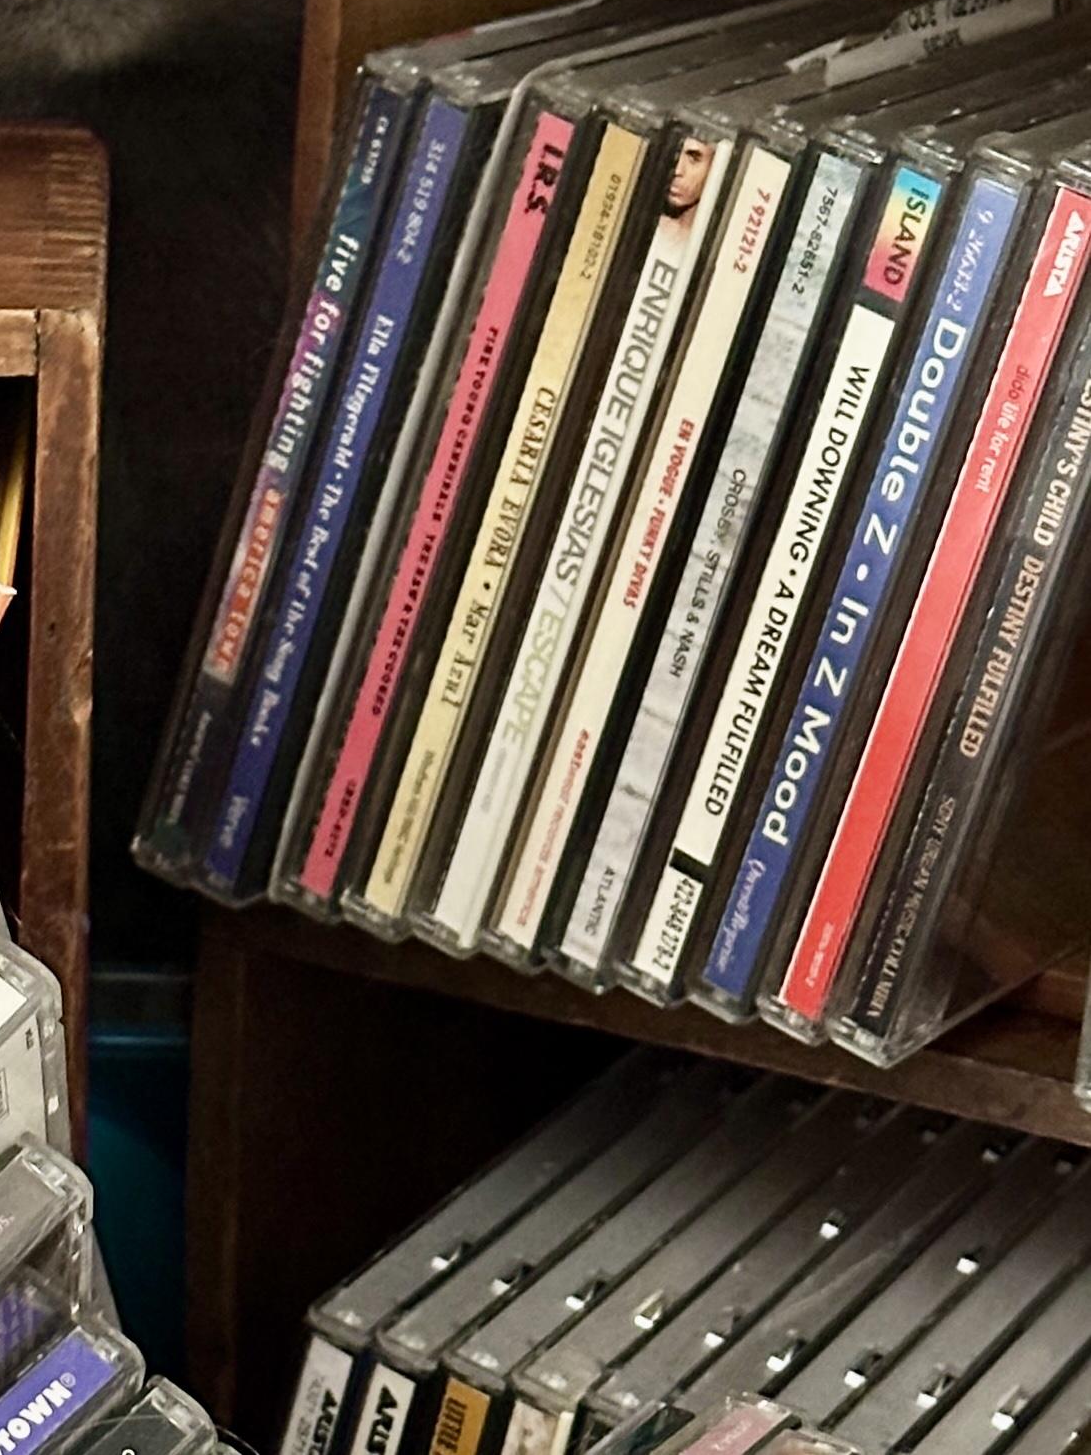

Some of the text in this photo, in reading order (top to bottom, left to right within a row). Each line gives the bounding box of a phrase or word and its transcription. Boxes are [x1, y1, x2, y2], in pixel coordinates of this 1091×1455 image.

[522, 141, 566, 219] I.R.S.
[974, 206, 995, 224] 9
[730, 187, 772, 274] 7 92121-2
[879, 186, 930, 287] ISLAND
[1041, 209, 1089, 301] ARISTA
[264, 233, 360, 474] five for fighting
[365, 313, 395, 358] Ella
[604, 257, 679, 424] ENRIQUE
[327, 360, 381, 469] Fitzgerald
[459, 369, 486, 426] YOUNG
[972, 363, 1032, 493] dido life for rent
[315, 482, 345, 523] The
[430, 427, 469, 523] CANNIBALS
[551, 425, 625, 586] IGLESIAS
[621, 417, 695, 609] EN VOGUE FUNKY DIVAS
[293, 570, 316, 599] of
[302, 524, 330, 568] Best
[441, 384, 558, 708] CESARIA EVORA Mar Azul
[667, 466, 747, 678] CROSBY, STILLS & NASH
[702, 362, 870, 817] WILL DOWNING A DREAM FULFILLED
[757, 316, 968, 846] Double Z In Z Mood
[955, 377, 1091, 759] STINY'S CHILD DESTINY FULFILLED
[262, 635, 296, 683] Song
[282, 598, 308, 636] the
[499, 606, 565, 746] ESCAPE
[584, 865, 617, 935] ATLANTIC
